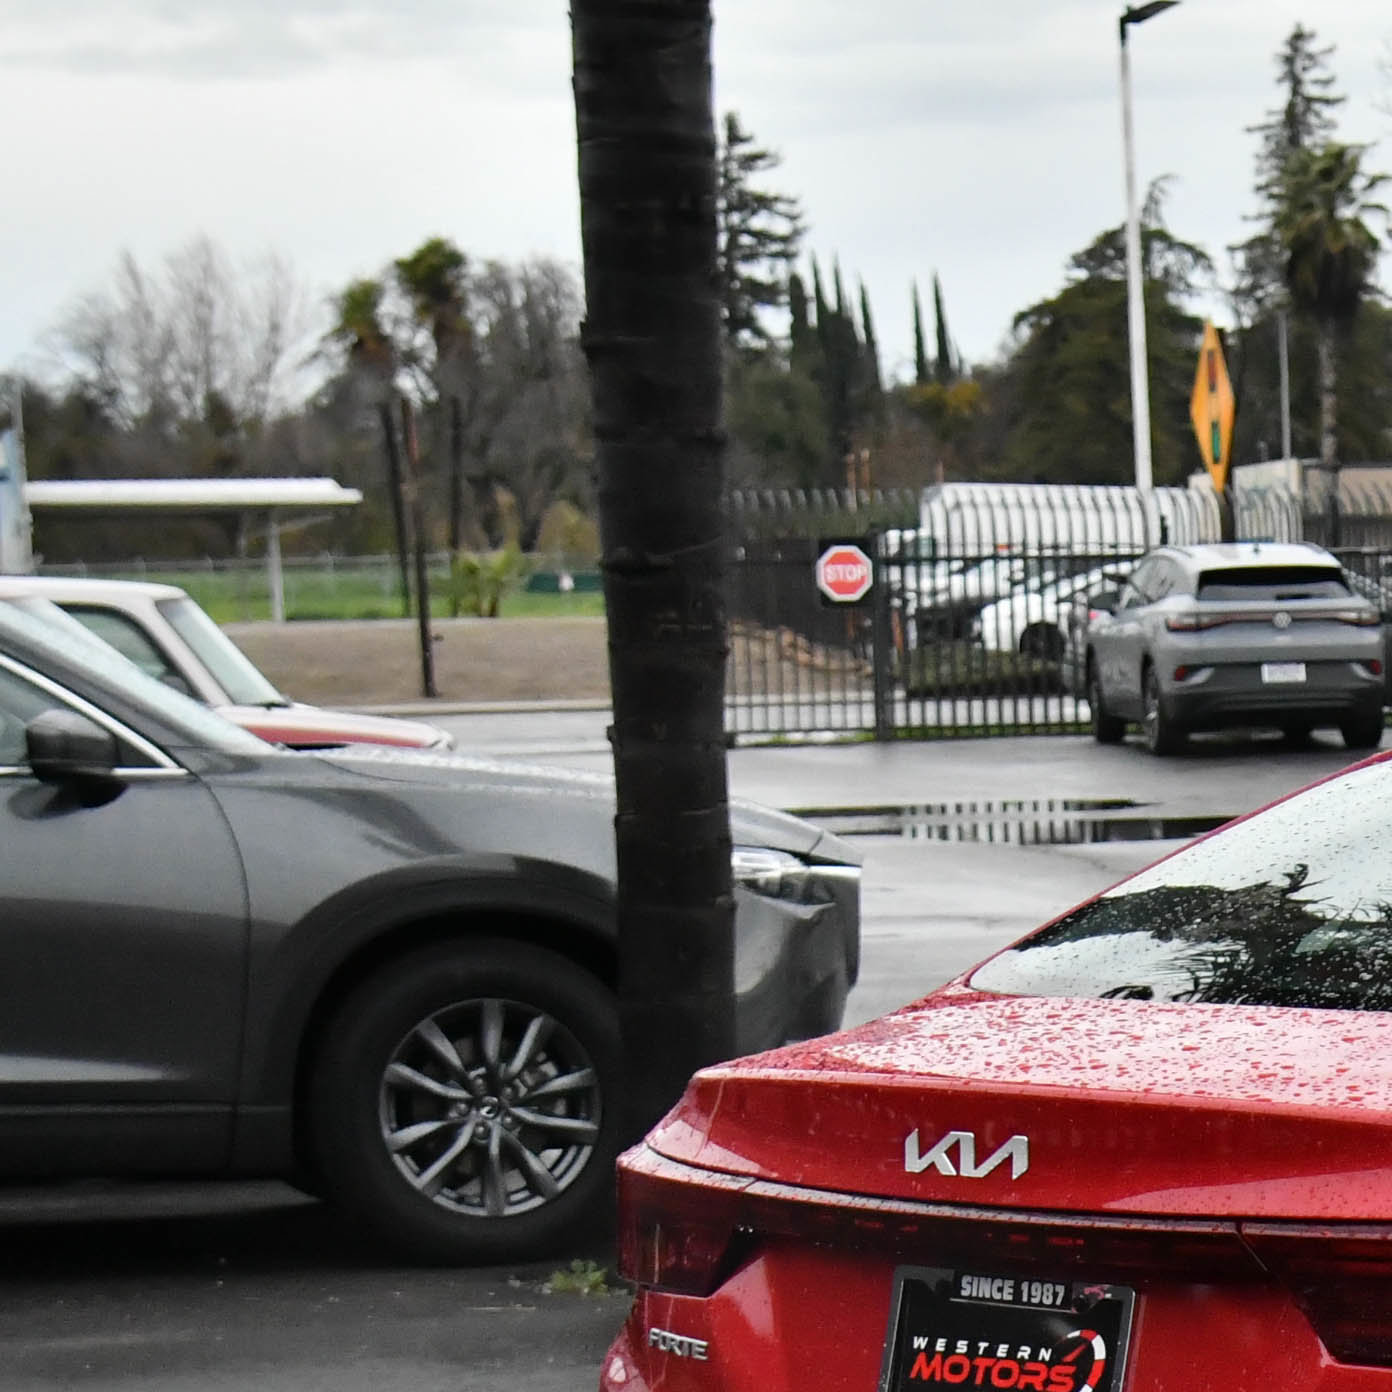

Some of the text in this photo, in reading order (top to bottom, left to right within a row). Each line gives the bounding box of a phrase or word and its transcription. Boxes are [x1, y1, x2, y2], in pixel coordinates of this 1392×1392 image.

[825, 564, 867, 583] STOP
[905, 1128, 1029, 1180] KIA
[960, 1275, 1065, 1306] SINCE 1987
[649, 1327, 708, 1360] FORTE
[912, 1335, 1052, 1361] WESTERN
